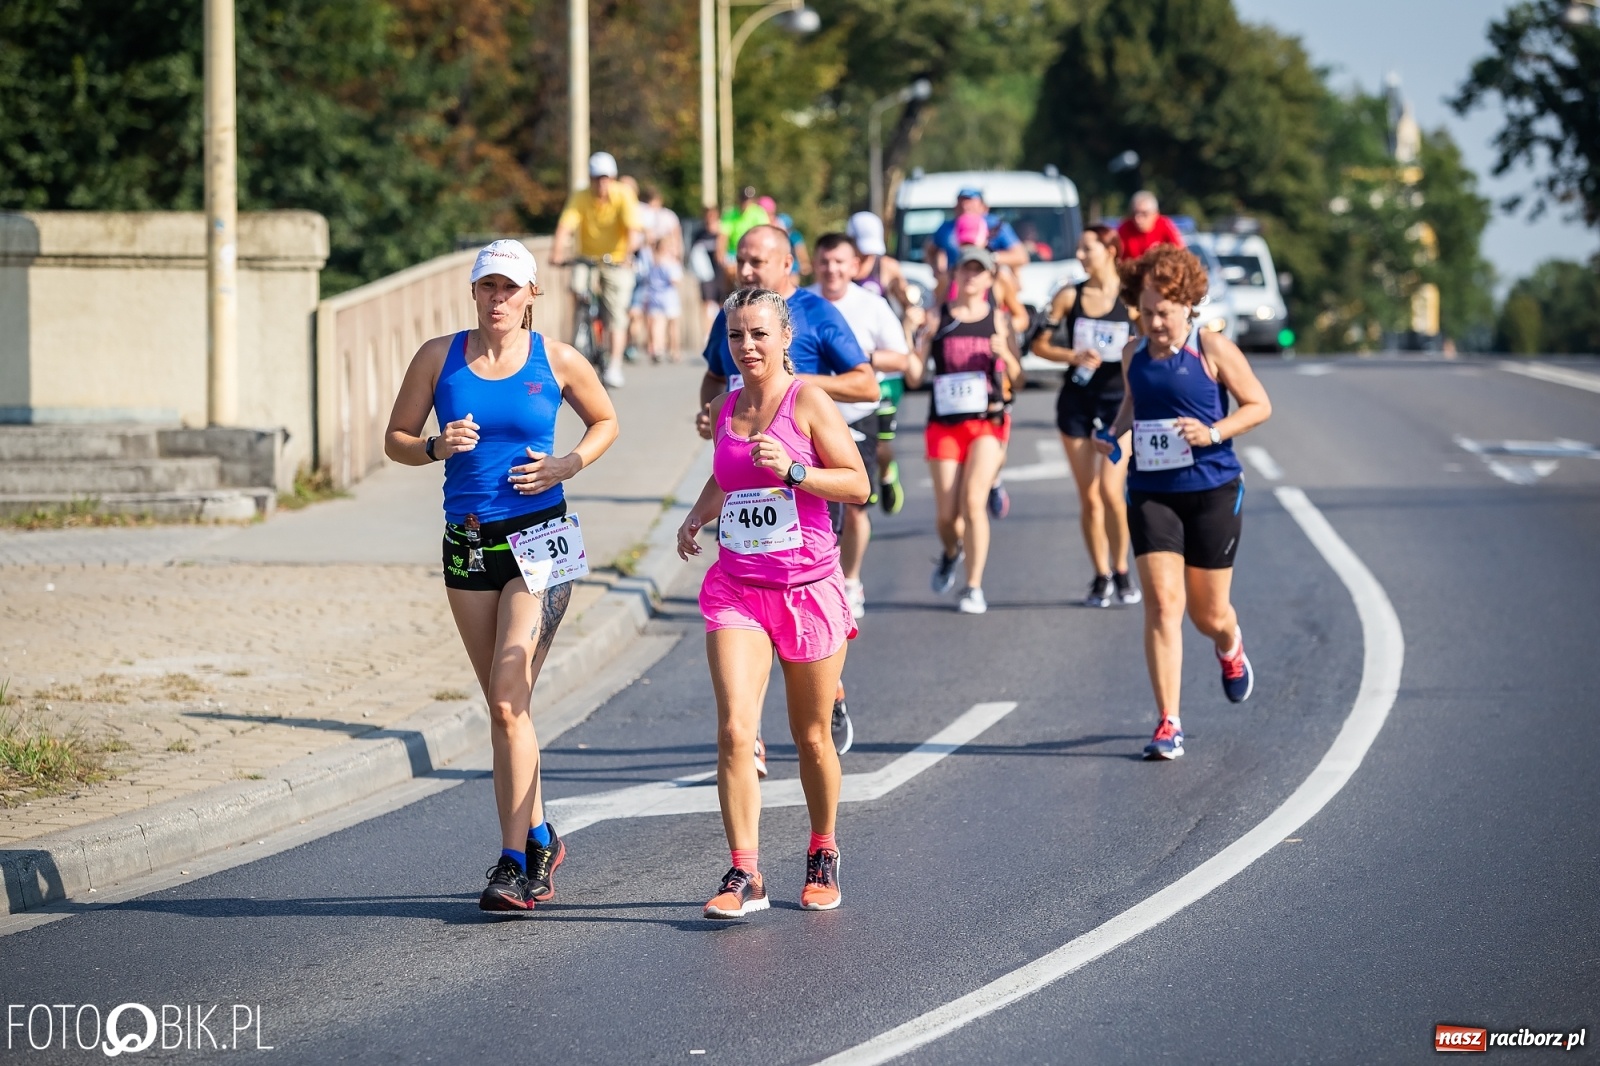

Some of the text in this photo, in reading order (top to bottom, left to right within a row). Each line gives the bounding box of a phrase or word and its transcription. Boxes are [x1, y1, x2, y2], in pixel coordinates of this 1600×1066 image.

[1149, 434, 1169, 450] 48
[738, 505, 777, 529] 460
[545, 535, 569, 559] 30
